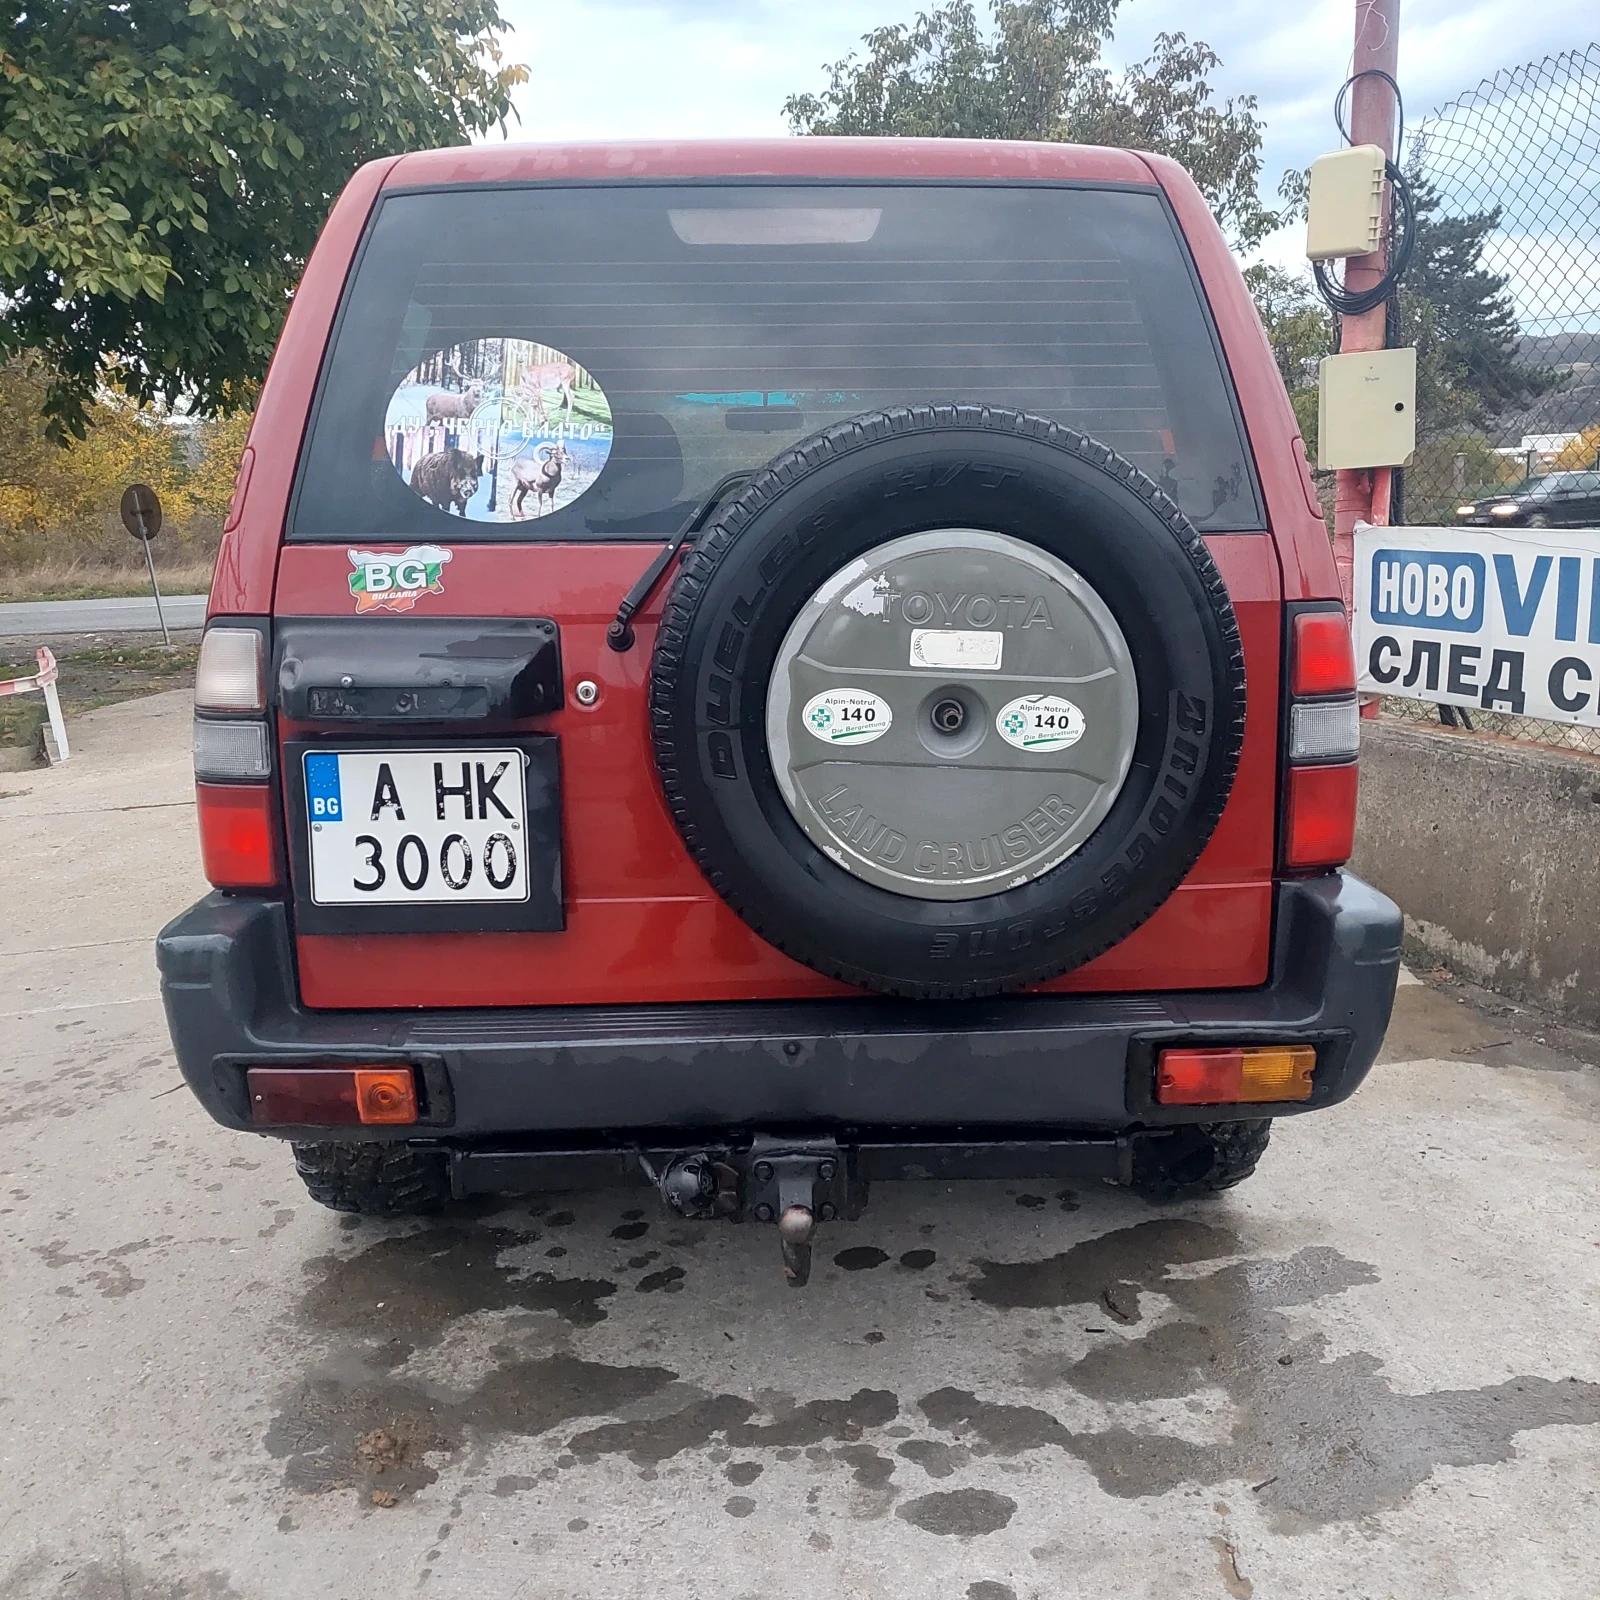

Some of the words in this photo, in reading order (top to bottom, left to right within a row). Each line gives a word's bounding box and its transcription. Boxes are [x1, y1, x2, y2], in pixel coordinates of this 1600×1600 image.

[391, 415, 421, 437] ДУ
[364, 559, 428, 592] BG
[371, 590, 418, 601] BULGARIA
[1377, 560, 1476, 622] НОВО
[874, 590, 1055, 630] TOYOTA
[1369, 635, 1527, 715] СЛЕД
[1548, 656, 1600, 717] С
[824, 697, 876, 706] Alpin-Notruf
[1019, 704, 1071, 713] Alpin-Notruf
[841, 707, 876, 722] 140
[1034, 714, 1070, 730] 140
[845, 721, 887, 732] Bergrettung
[1037, 729, 1079, 739] Bergrettung
[370, 762, 406, 821] A
[432, 761, 516, 820] HK
[313, 797, 339, 815] BG
[817, 783, 908, 866] LAND
[913, 793, 1077, 875] CRUISER
[353, 832, 517, 891] 3000
